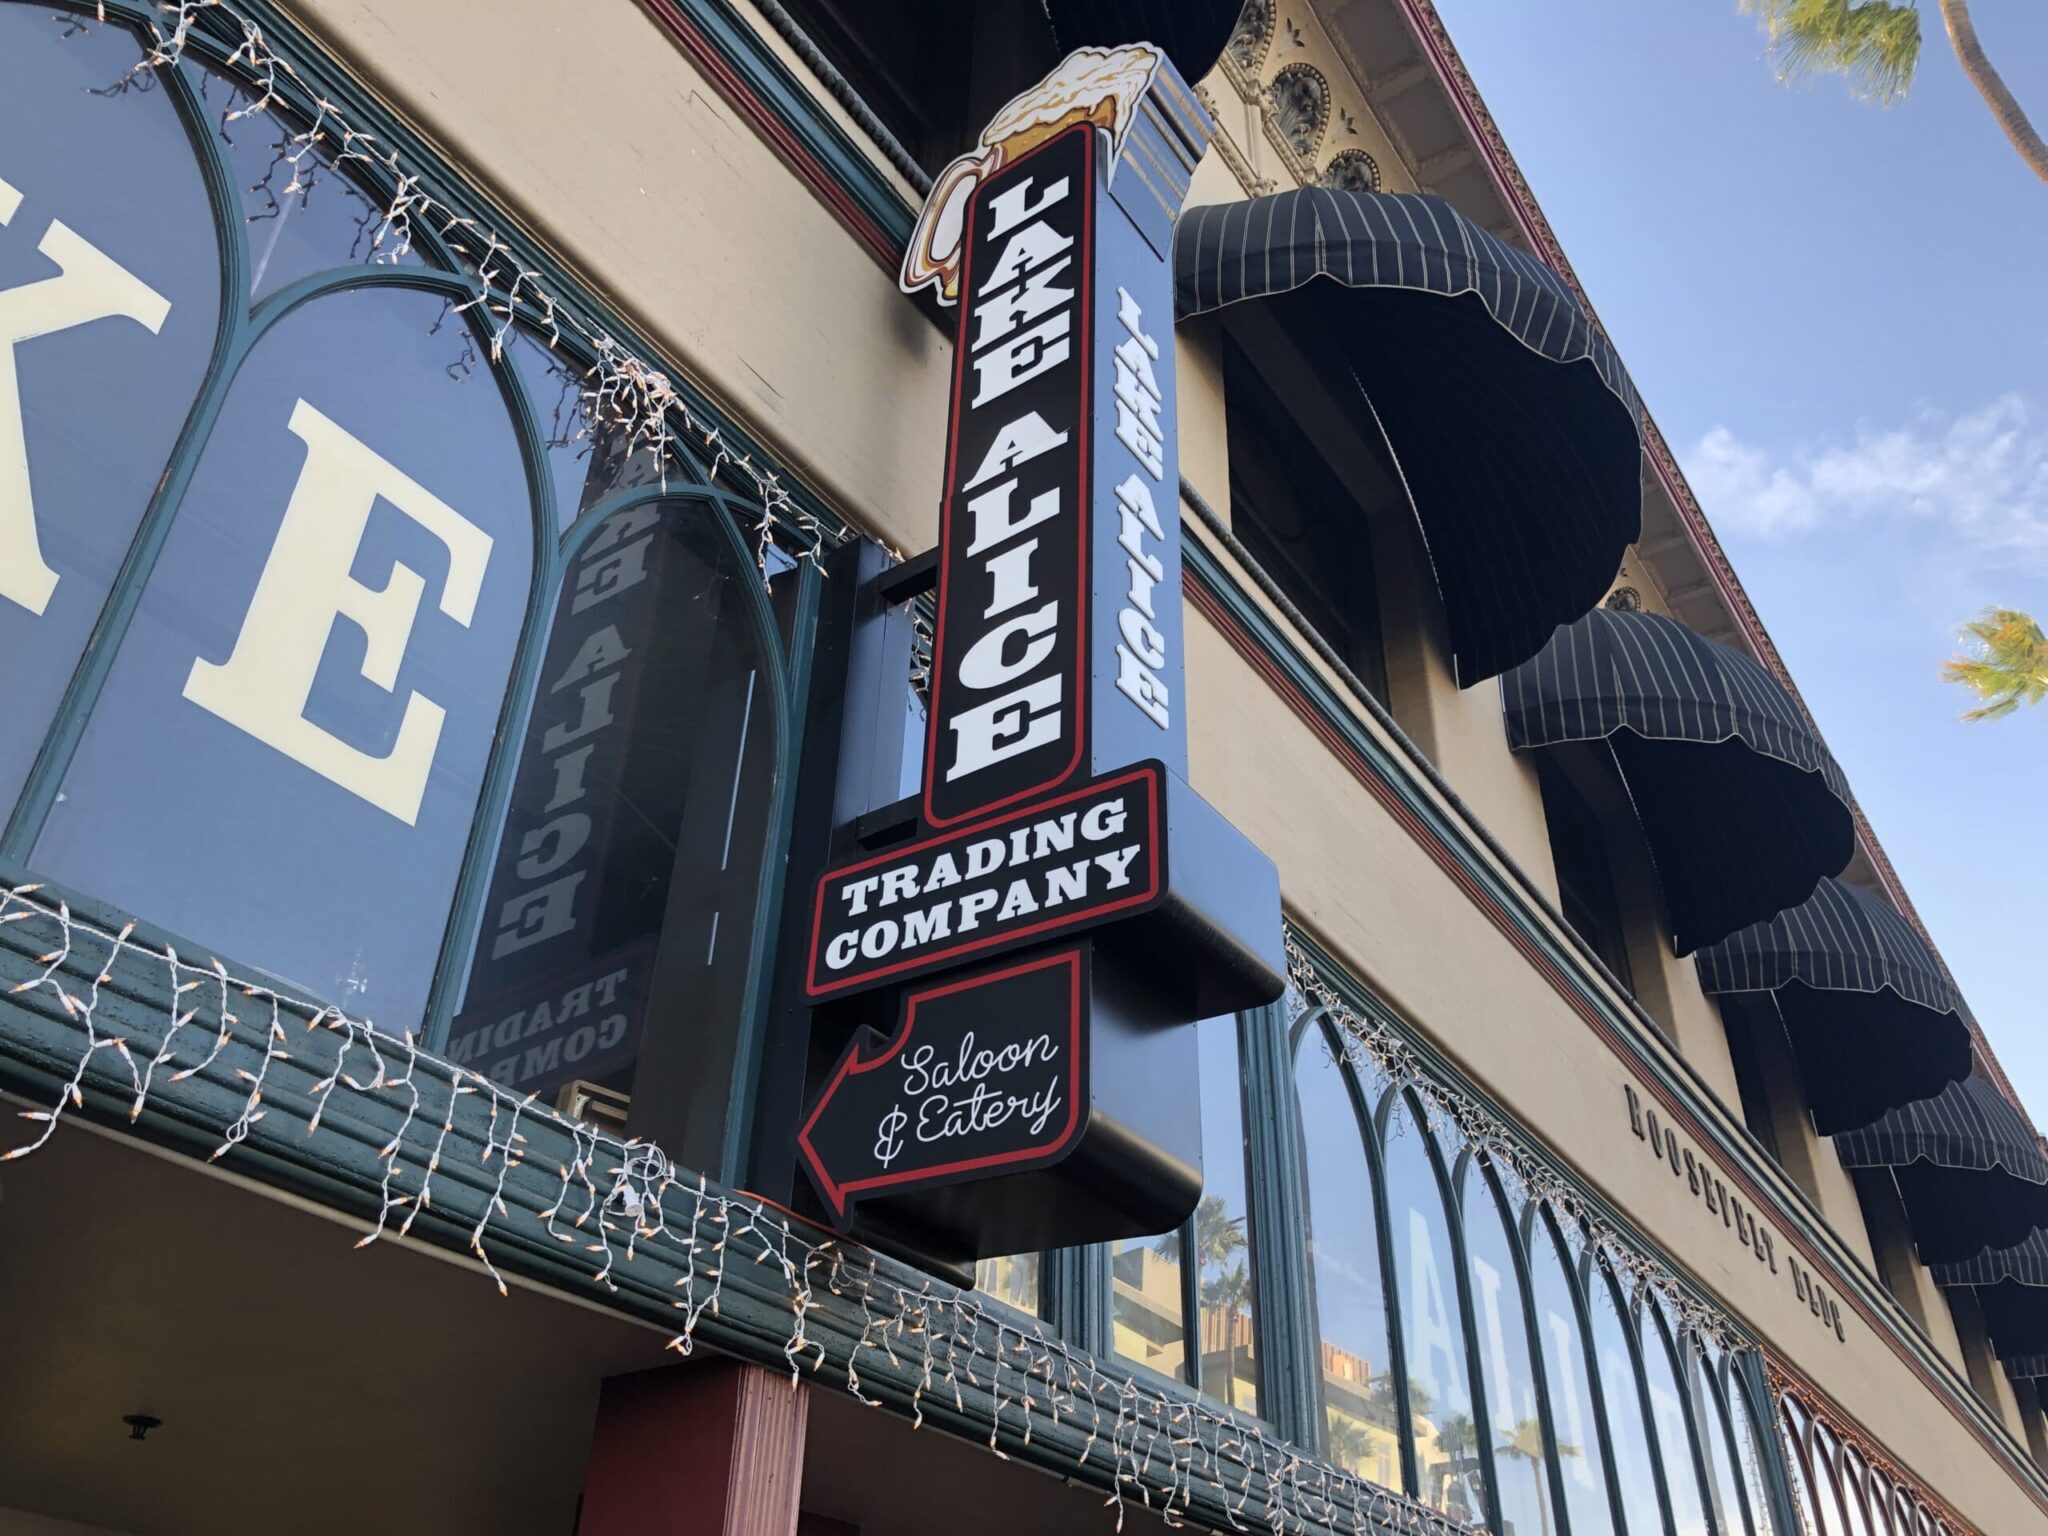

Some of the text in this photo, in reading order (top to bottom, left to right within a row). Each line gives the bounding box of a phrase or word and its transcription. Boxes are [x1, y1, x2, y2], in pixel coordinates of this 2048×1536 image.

[945, 174, 1075, 783] LAKE ALICE
[1113, 285, 1170, 730] LAKE ALICE
[824, 844, 1142, 970] COMPANY
[841, 797, 1129, 917] TRADING
[873, 1074, 1062, 1169] & Eatery
[900, 1030, 1060, 1096] Saloon
[1623, 1083, 1845, 1343] ROOSEVELT BLDG
